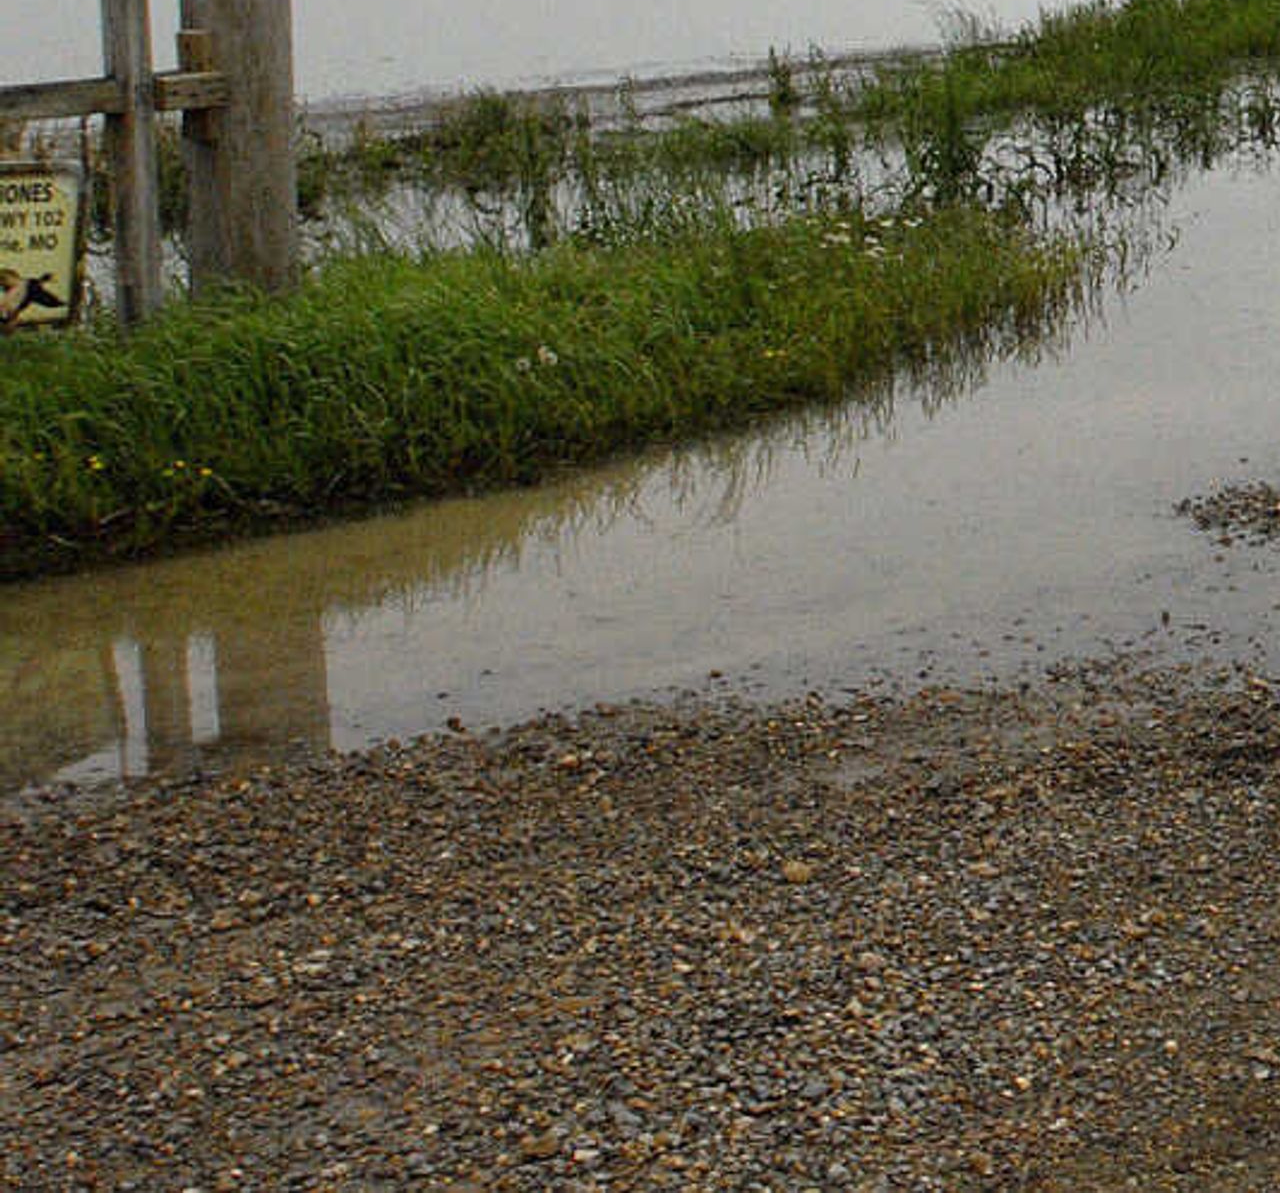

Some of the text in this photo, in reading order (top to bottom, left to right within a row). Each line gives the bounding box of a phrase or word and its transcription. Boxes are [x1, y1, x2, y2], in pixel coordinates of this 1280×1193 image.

[0, 183, 55, 204] ONES
[35, 209, 65, 227] 102
[29, 233, 58, 250] MO
